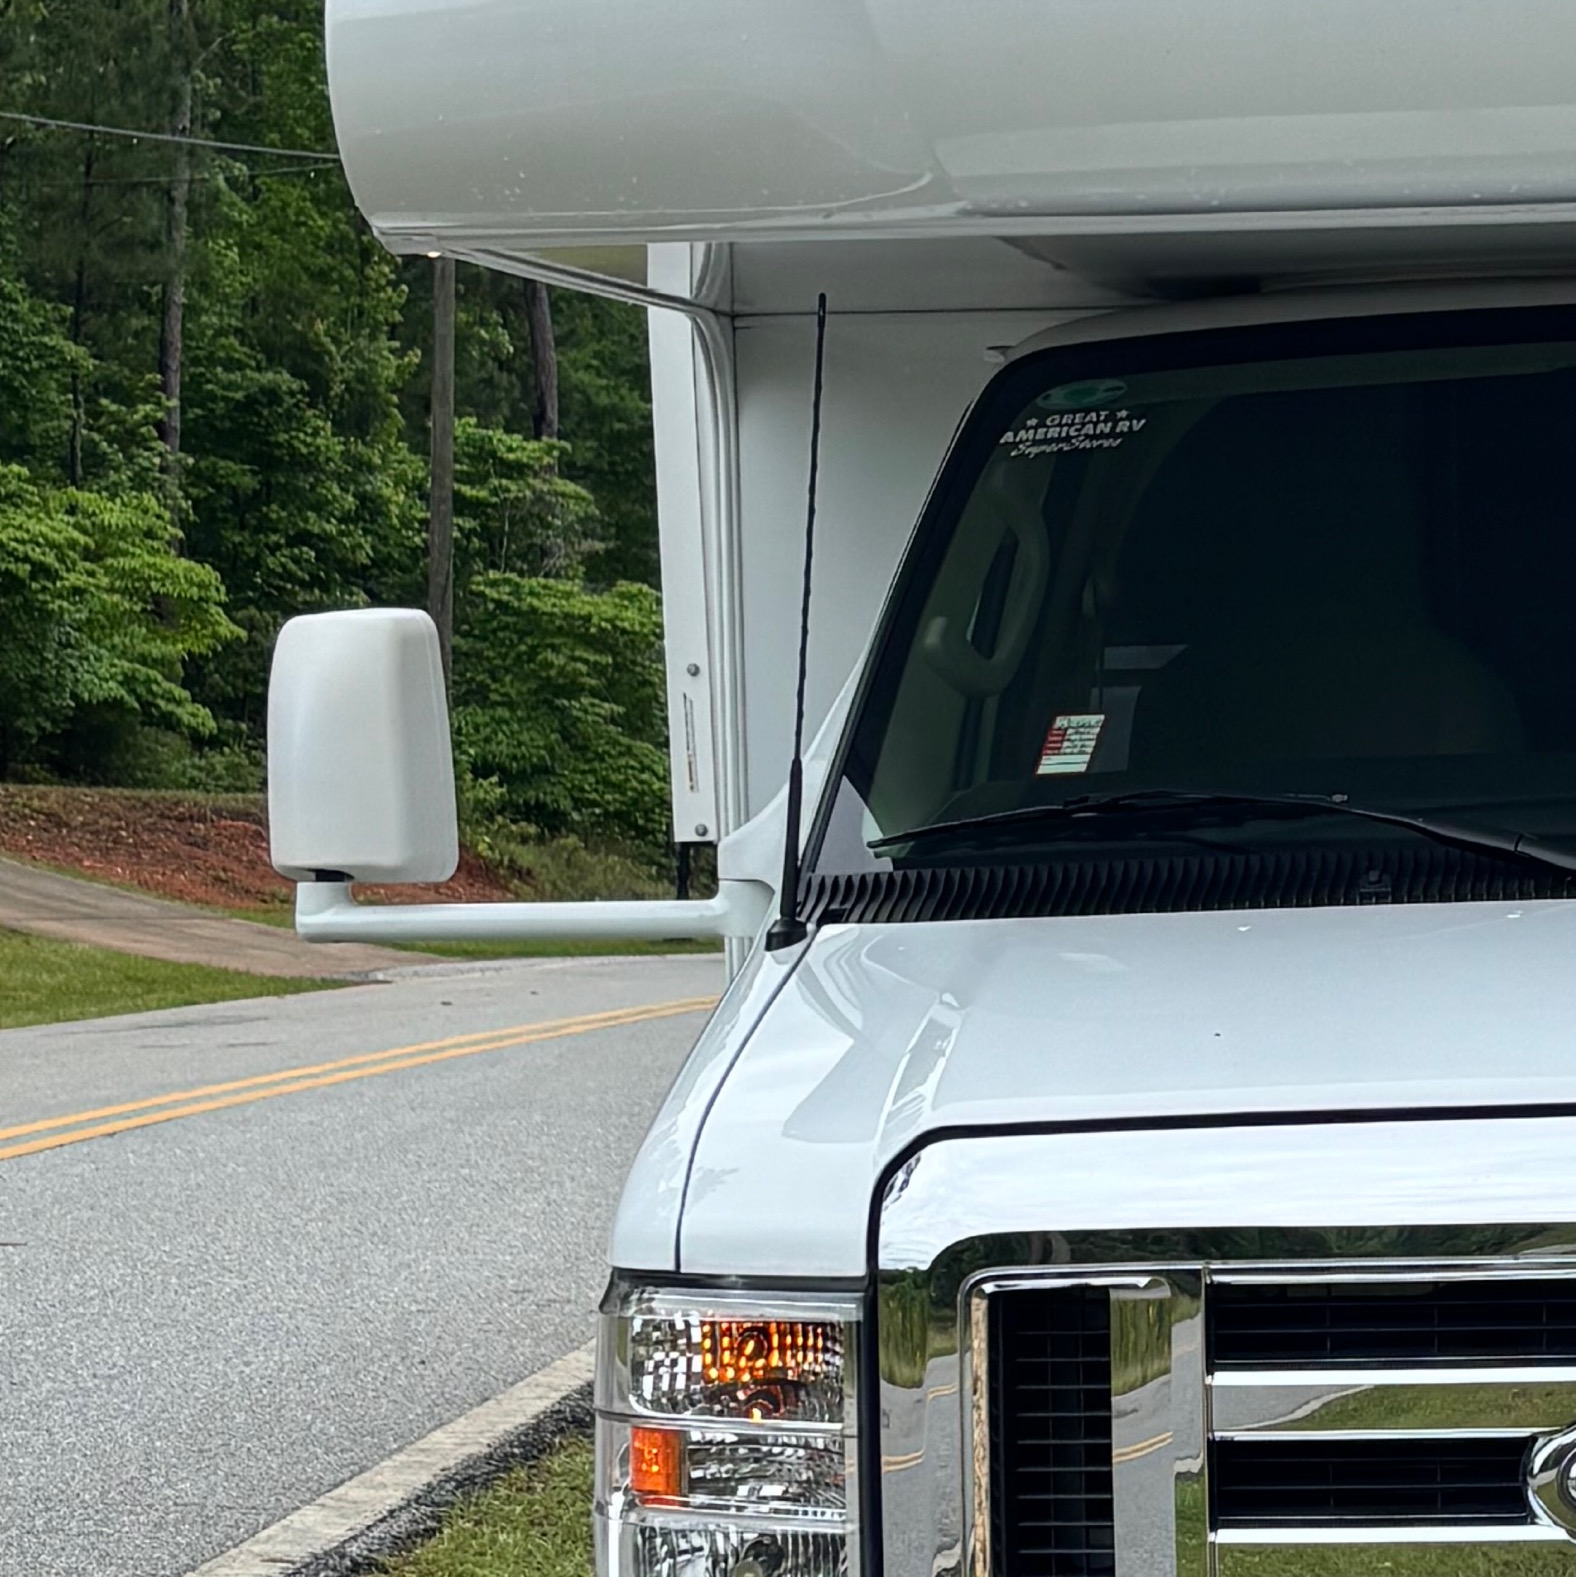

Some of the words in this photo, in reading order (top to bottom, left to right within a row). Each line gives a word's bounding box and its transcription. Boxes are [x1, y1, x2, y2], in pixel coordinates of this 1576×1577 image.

[1045, 410, 1110, 426] GREAT
[999, 422, 1113, 445] AMERICAN
[1115, 418, 1147, 434] RV
